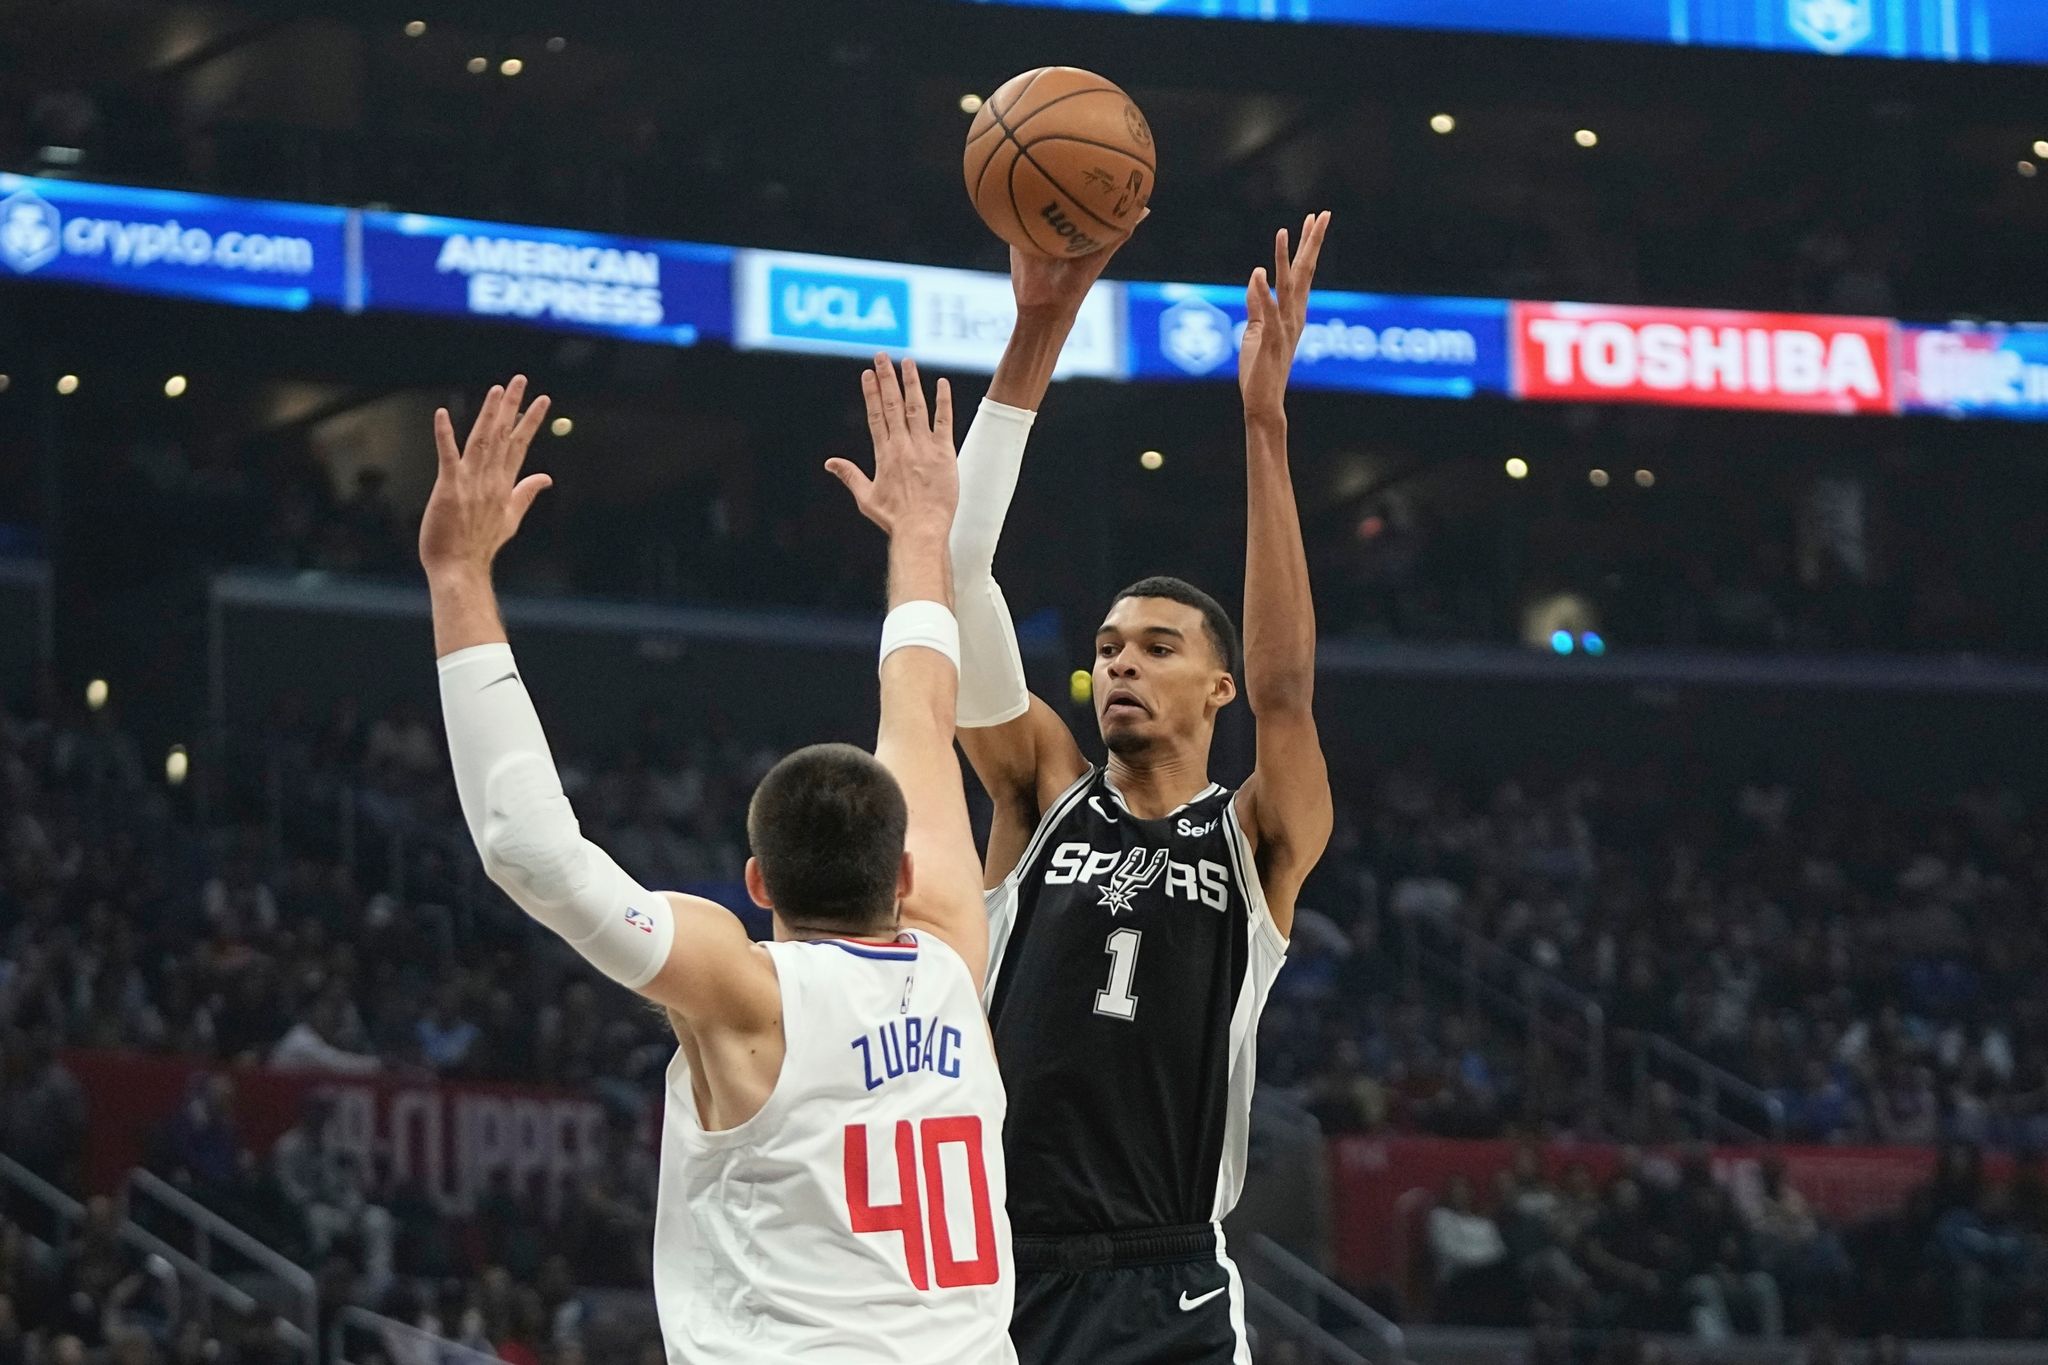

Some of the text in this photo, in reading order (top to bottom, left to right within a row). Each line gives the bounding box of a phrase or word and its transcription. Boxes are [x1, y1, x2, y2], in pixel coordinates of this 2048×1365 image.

[63, 216, 313, 275] crypto.com
[436, 234, 660, 288] AMERICAN
[468, 273, 664, 325] EXPRESS
[783, 284, 898, 332] UCLA
[1529, 320, 1882, 398] TOSHIBA
[1044, 842, 1229, 916] SPURS
[1093, 927, 1142, 1021] 1
[851, 1016, 961, 1091] ZUBAC
[844, 1115, 999, 1290] 40
